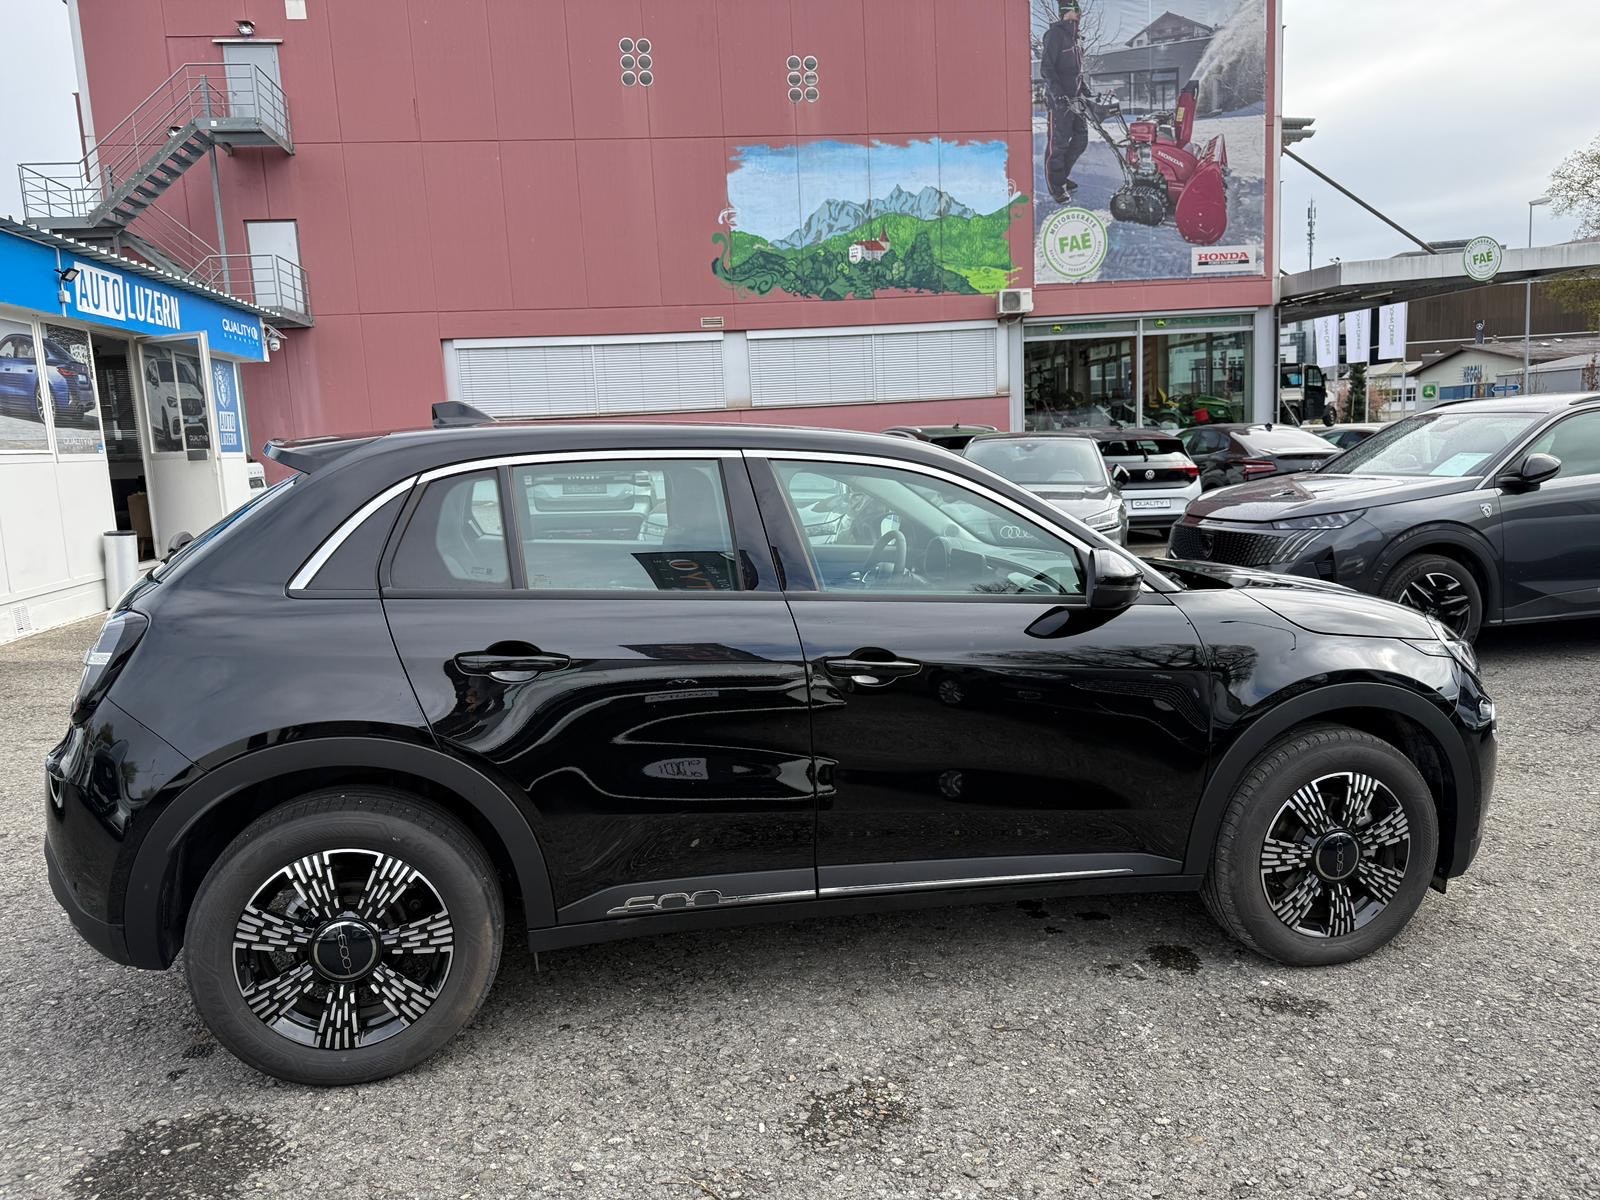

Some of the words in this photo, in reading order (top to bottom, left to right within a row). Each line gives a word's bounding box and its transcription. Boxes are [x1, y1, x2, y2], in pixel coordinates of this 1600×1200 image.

[1157, 150, 1184, 168] HONDA
[1058, 228, 1092, 254] FAÉ
[1197, 252, 1249, 262] HONDA
[1472, 247, 1493, 265] FAÉ
[79, 268, 121, 315] AUTO
[125, 282, 180, 330] LUZERN
